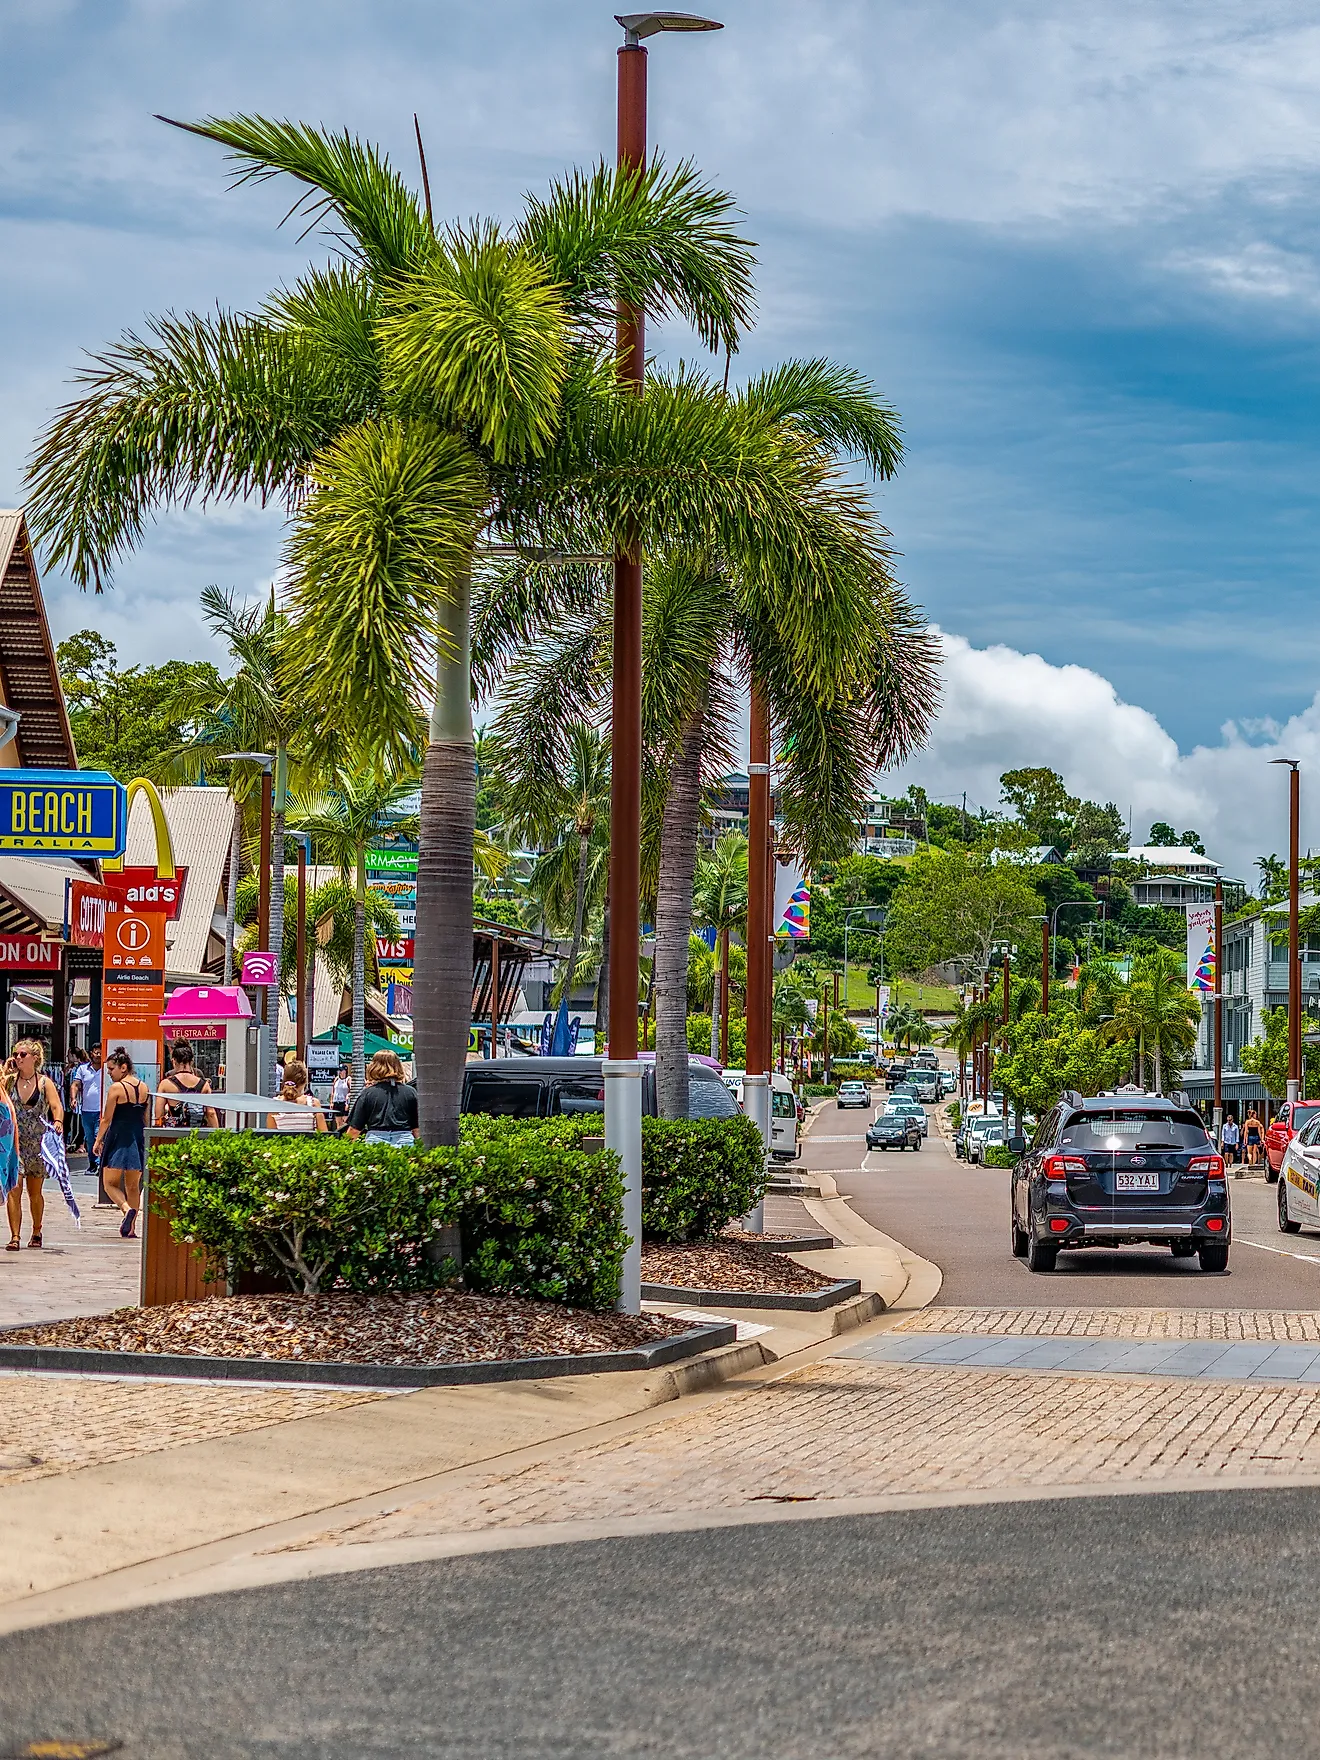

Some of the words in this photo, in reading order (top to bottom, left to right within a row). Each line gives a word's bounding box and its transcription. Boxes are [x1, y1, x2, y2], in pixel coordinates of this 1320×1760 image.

[11, 790, 92, 834] BEACH
[380, 972, 396, 984] ski
[171, 1029, 202, 1038] TELSTRA
